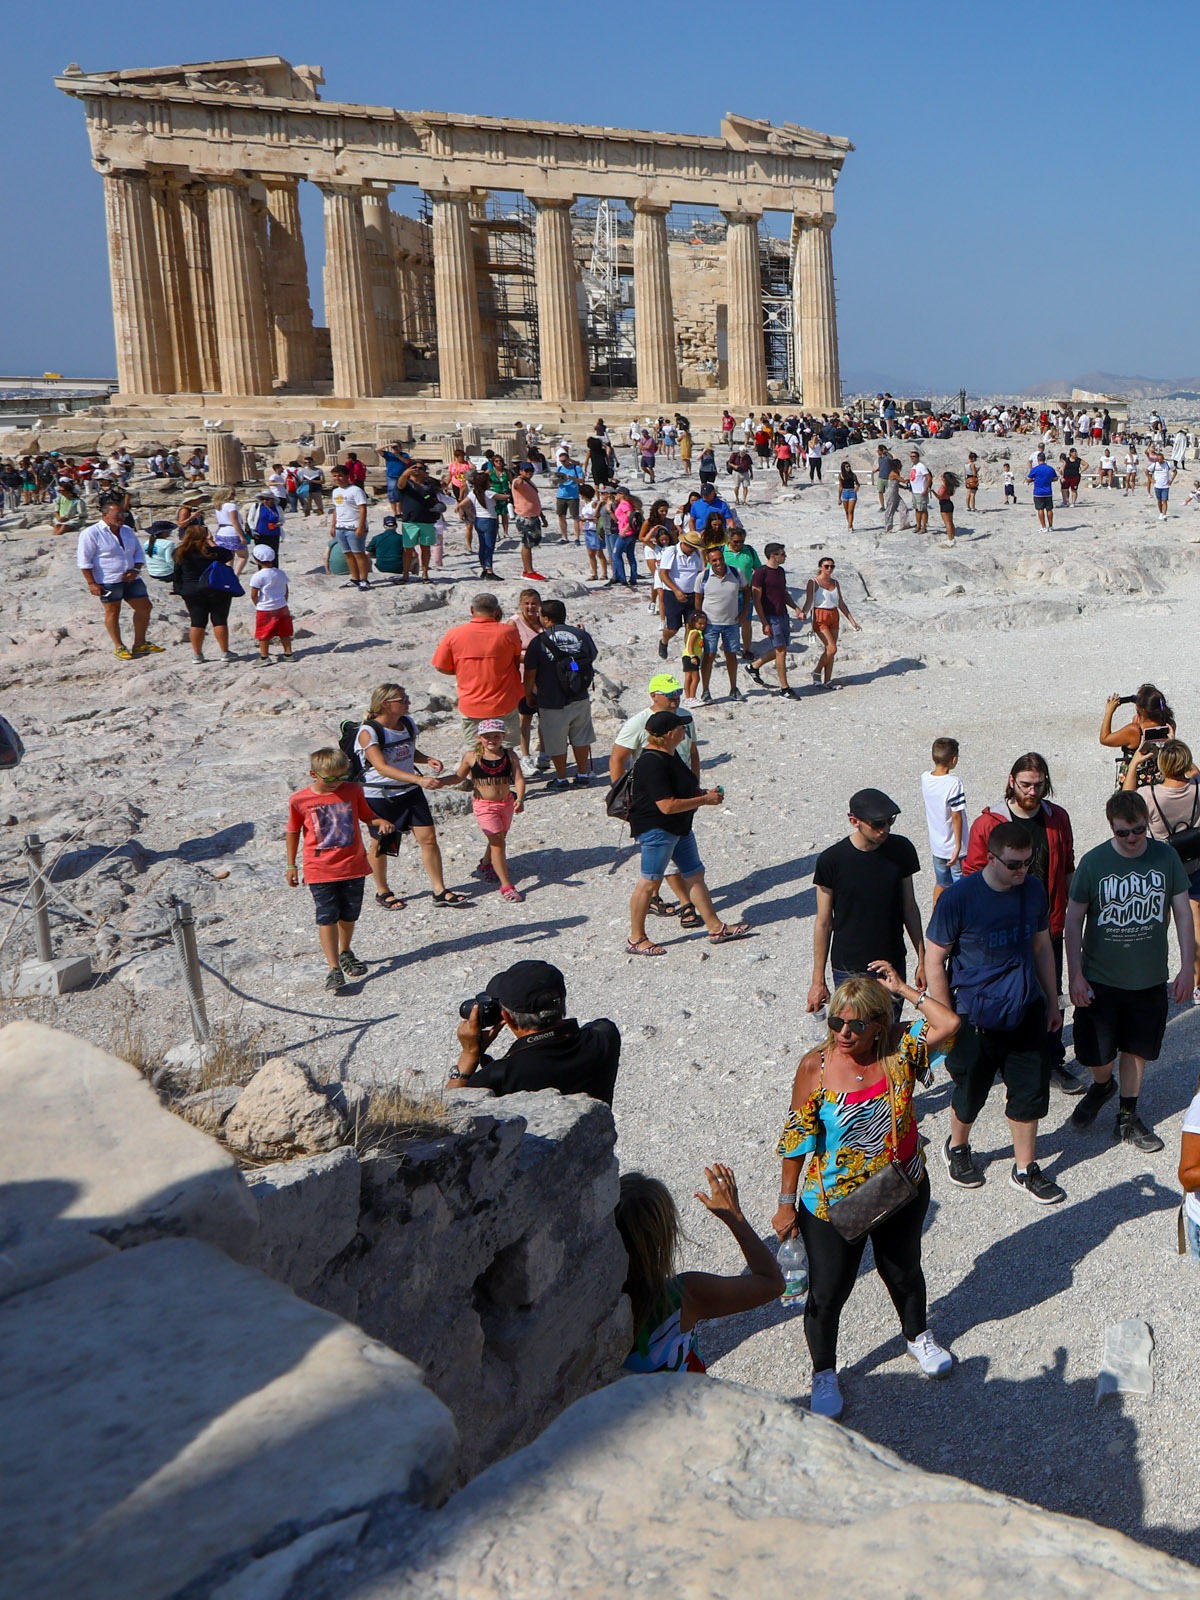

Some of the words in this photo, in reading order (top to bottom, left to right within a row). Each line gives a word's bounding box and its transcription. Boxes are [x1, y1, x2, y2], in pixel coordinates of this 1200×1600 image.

[1103, 872, 1162, 903] WORLD
[1102, 895, 1161, 925] FAMOUS
[526, 1031, 555, 1043] Canon
